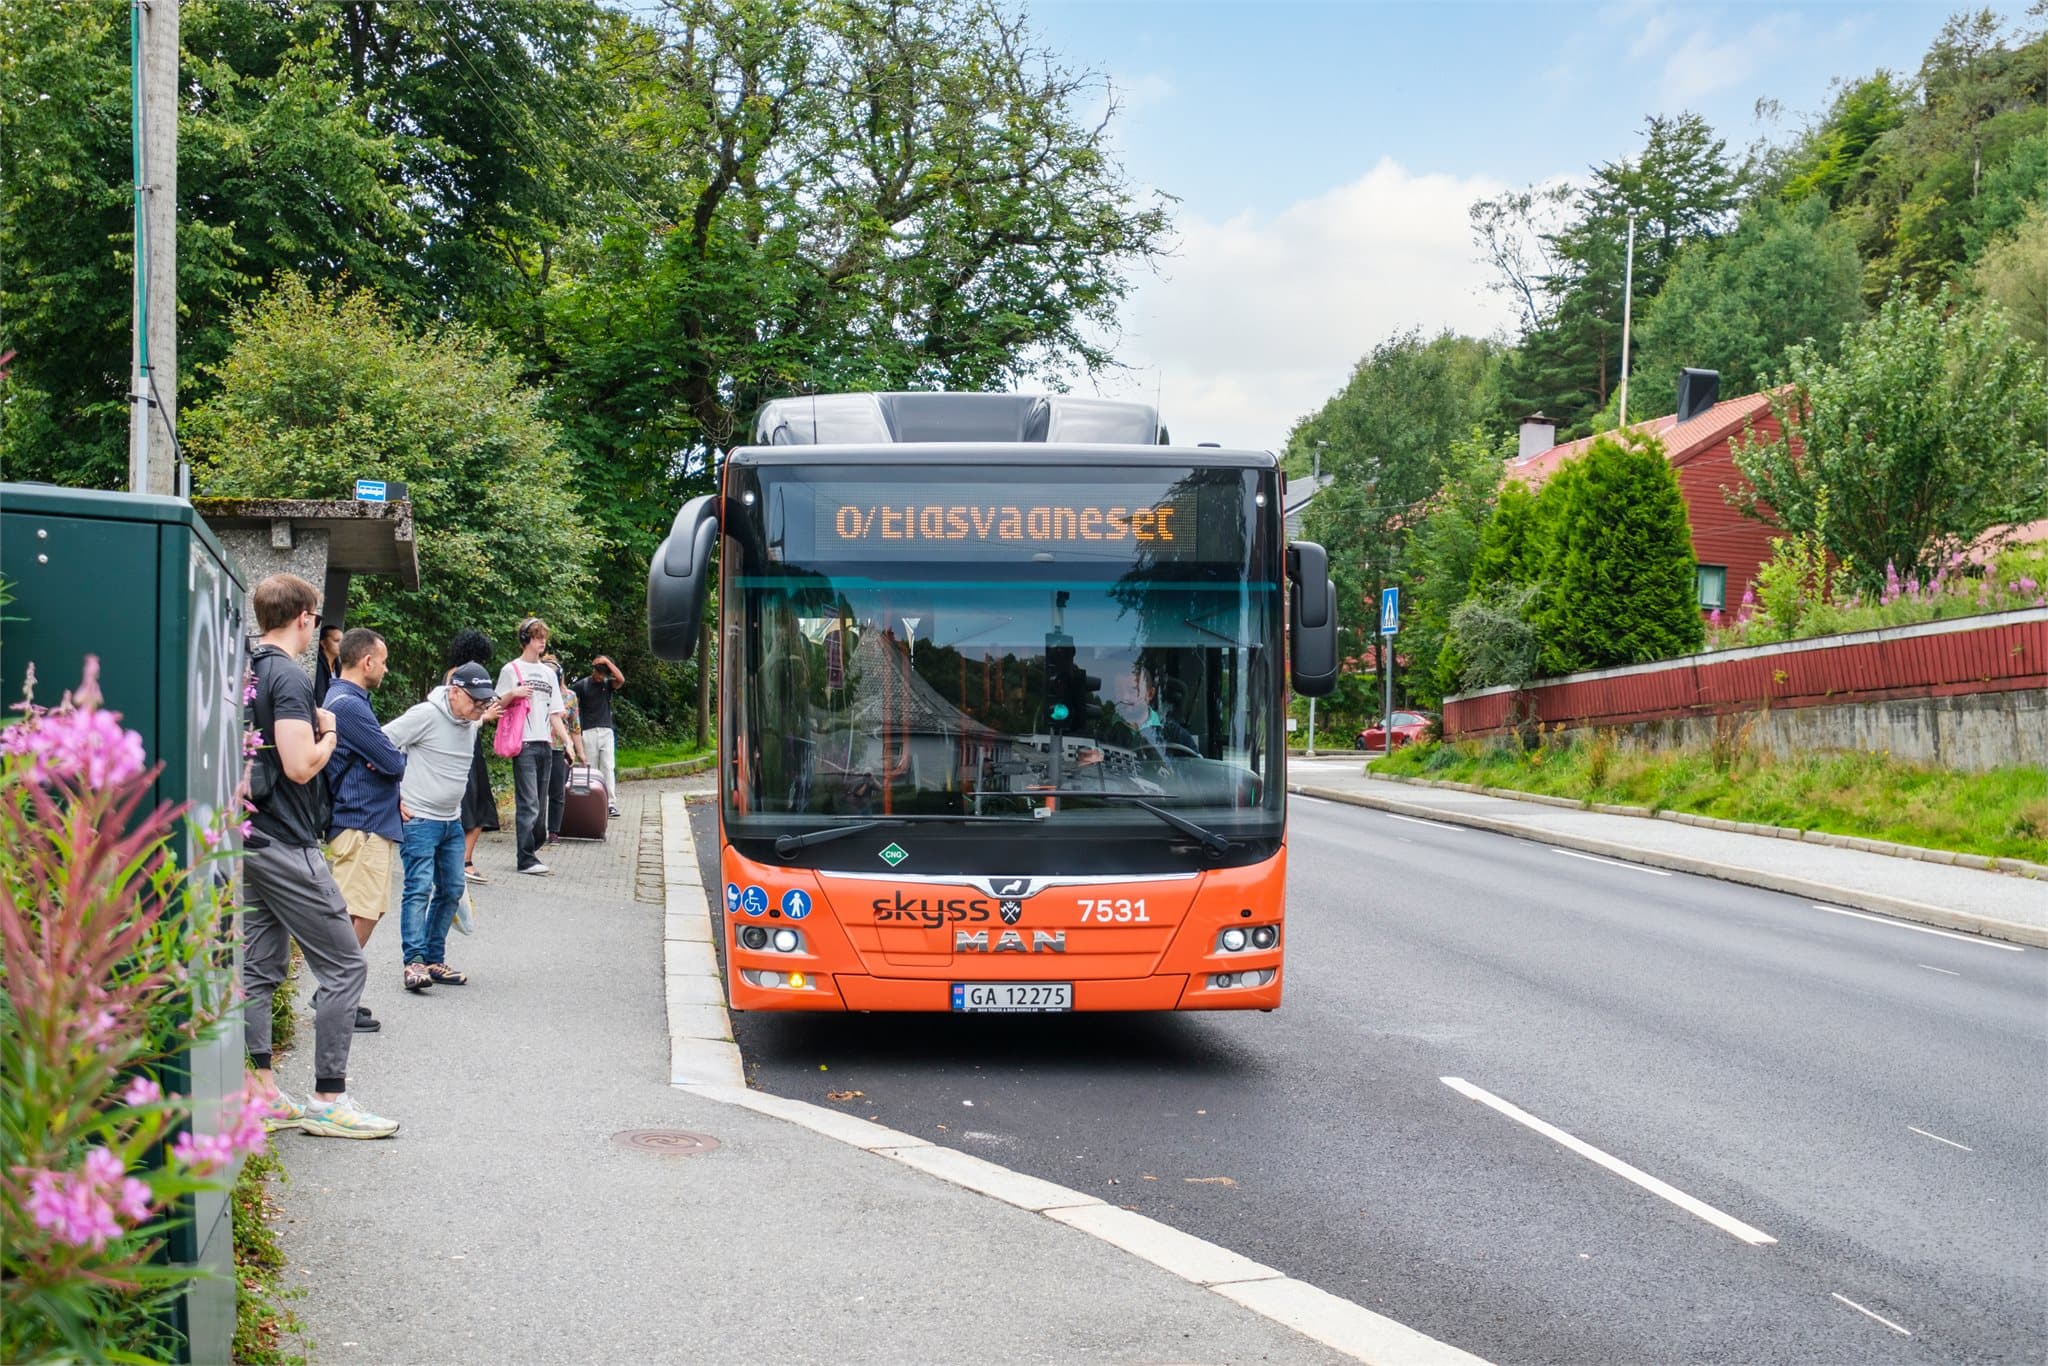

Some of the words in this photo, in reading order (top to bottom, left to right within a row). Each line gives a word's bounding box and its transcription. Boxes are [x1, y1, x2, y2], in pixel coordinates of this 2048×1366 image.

[885, 850, 902, 859] CNG
[872, 890, 990, 928] skyss
[1077, 899, 1150, 922] 7531
[955, 929, 1066, 953] MAN
[971, 988, 997, 1005] GA
[1006, 988, 1065, 1006] 12275
